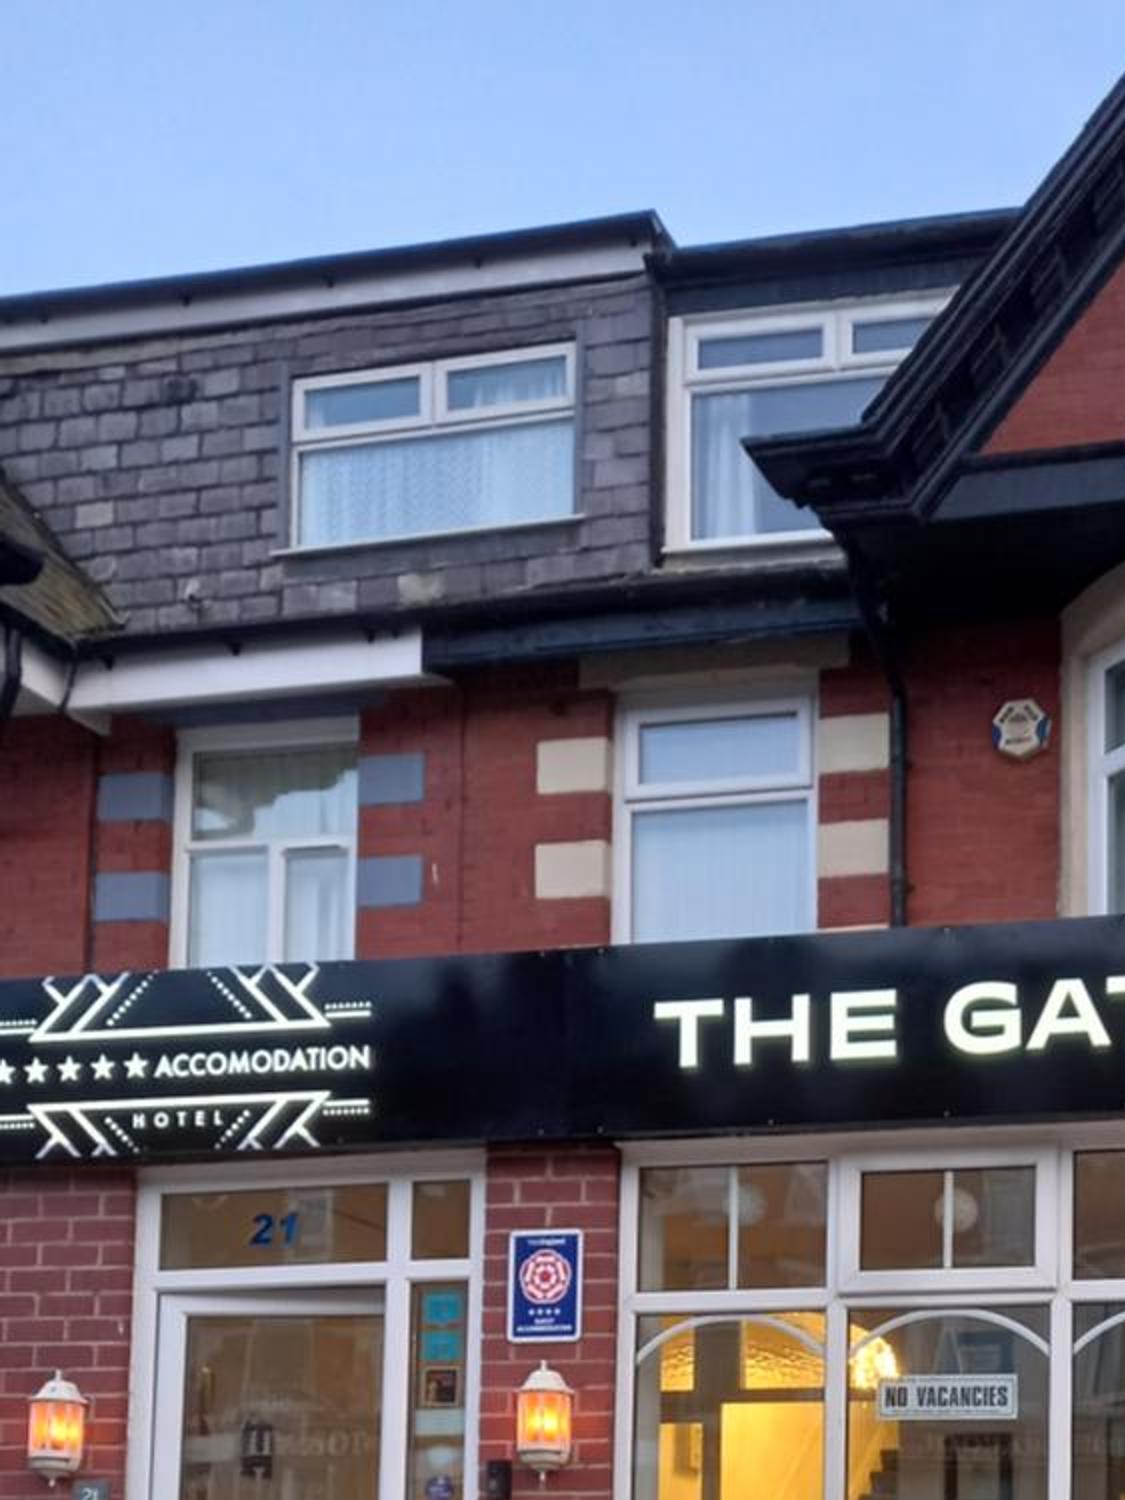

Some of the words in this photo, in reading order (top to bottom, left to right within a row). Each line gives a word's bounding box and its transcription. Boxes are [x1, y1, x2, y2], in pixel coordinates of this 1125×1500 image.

[653, 988, 898, 1069] THE
[154, 1044, 371, 1078] ACCOMODATION
[132, 1109, 223, 1129] HOTEL
[249, 1212, 298, 1246] 21
[885, 1387, 908, 1407] NO
[917, 1386, 1008, 1407] VACANCIES
